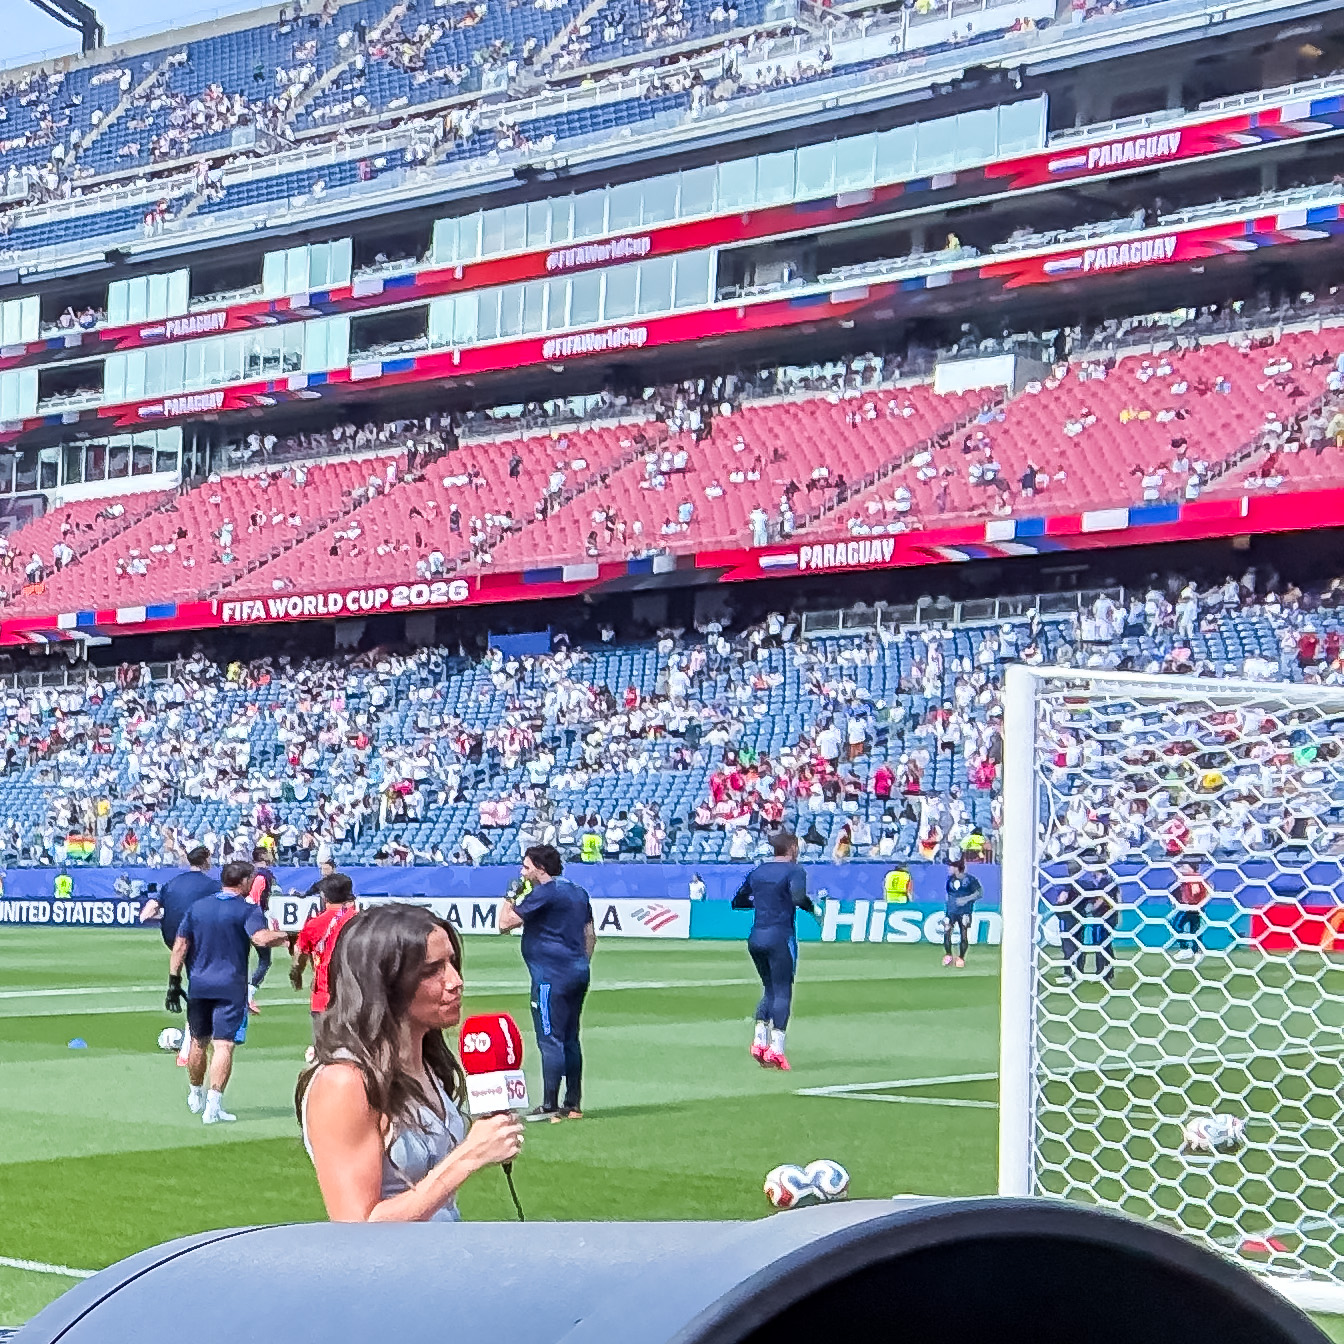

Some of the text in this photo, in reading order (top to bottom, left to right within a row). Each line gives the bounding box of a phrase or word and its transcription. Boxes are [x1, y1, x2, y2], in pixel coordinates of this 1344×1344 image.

[1088, 132, 1181, 169] PARAGUAY
[1084, 236, 1177, 272] PARAGUAY
[799, 539, 894, 569] PARAGUAY
[222, 580, 468, 622] FIFA WORLD CUP 2026
[52, 901, 113, 924] STATES
[116, 902, 140, 924] OF
